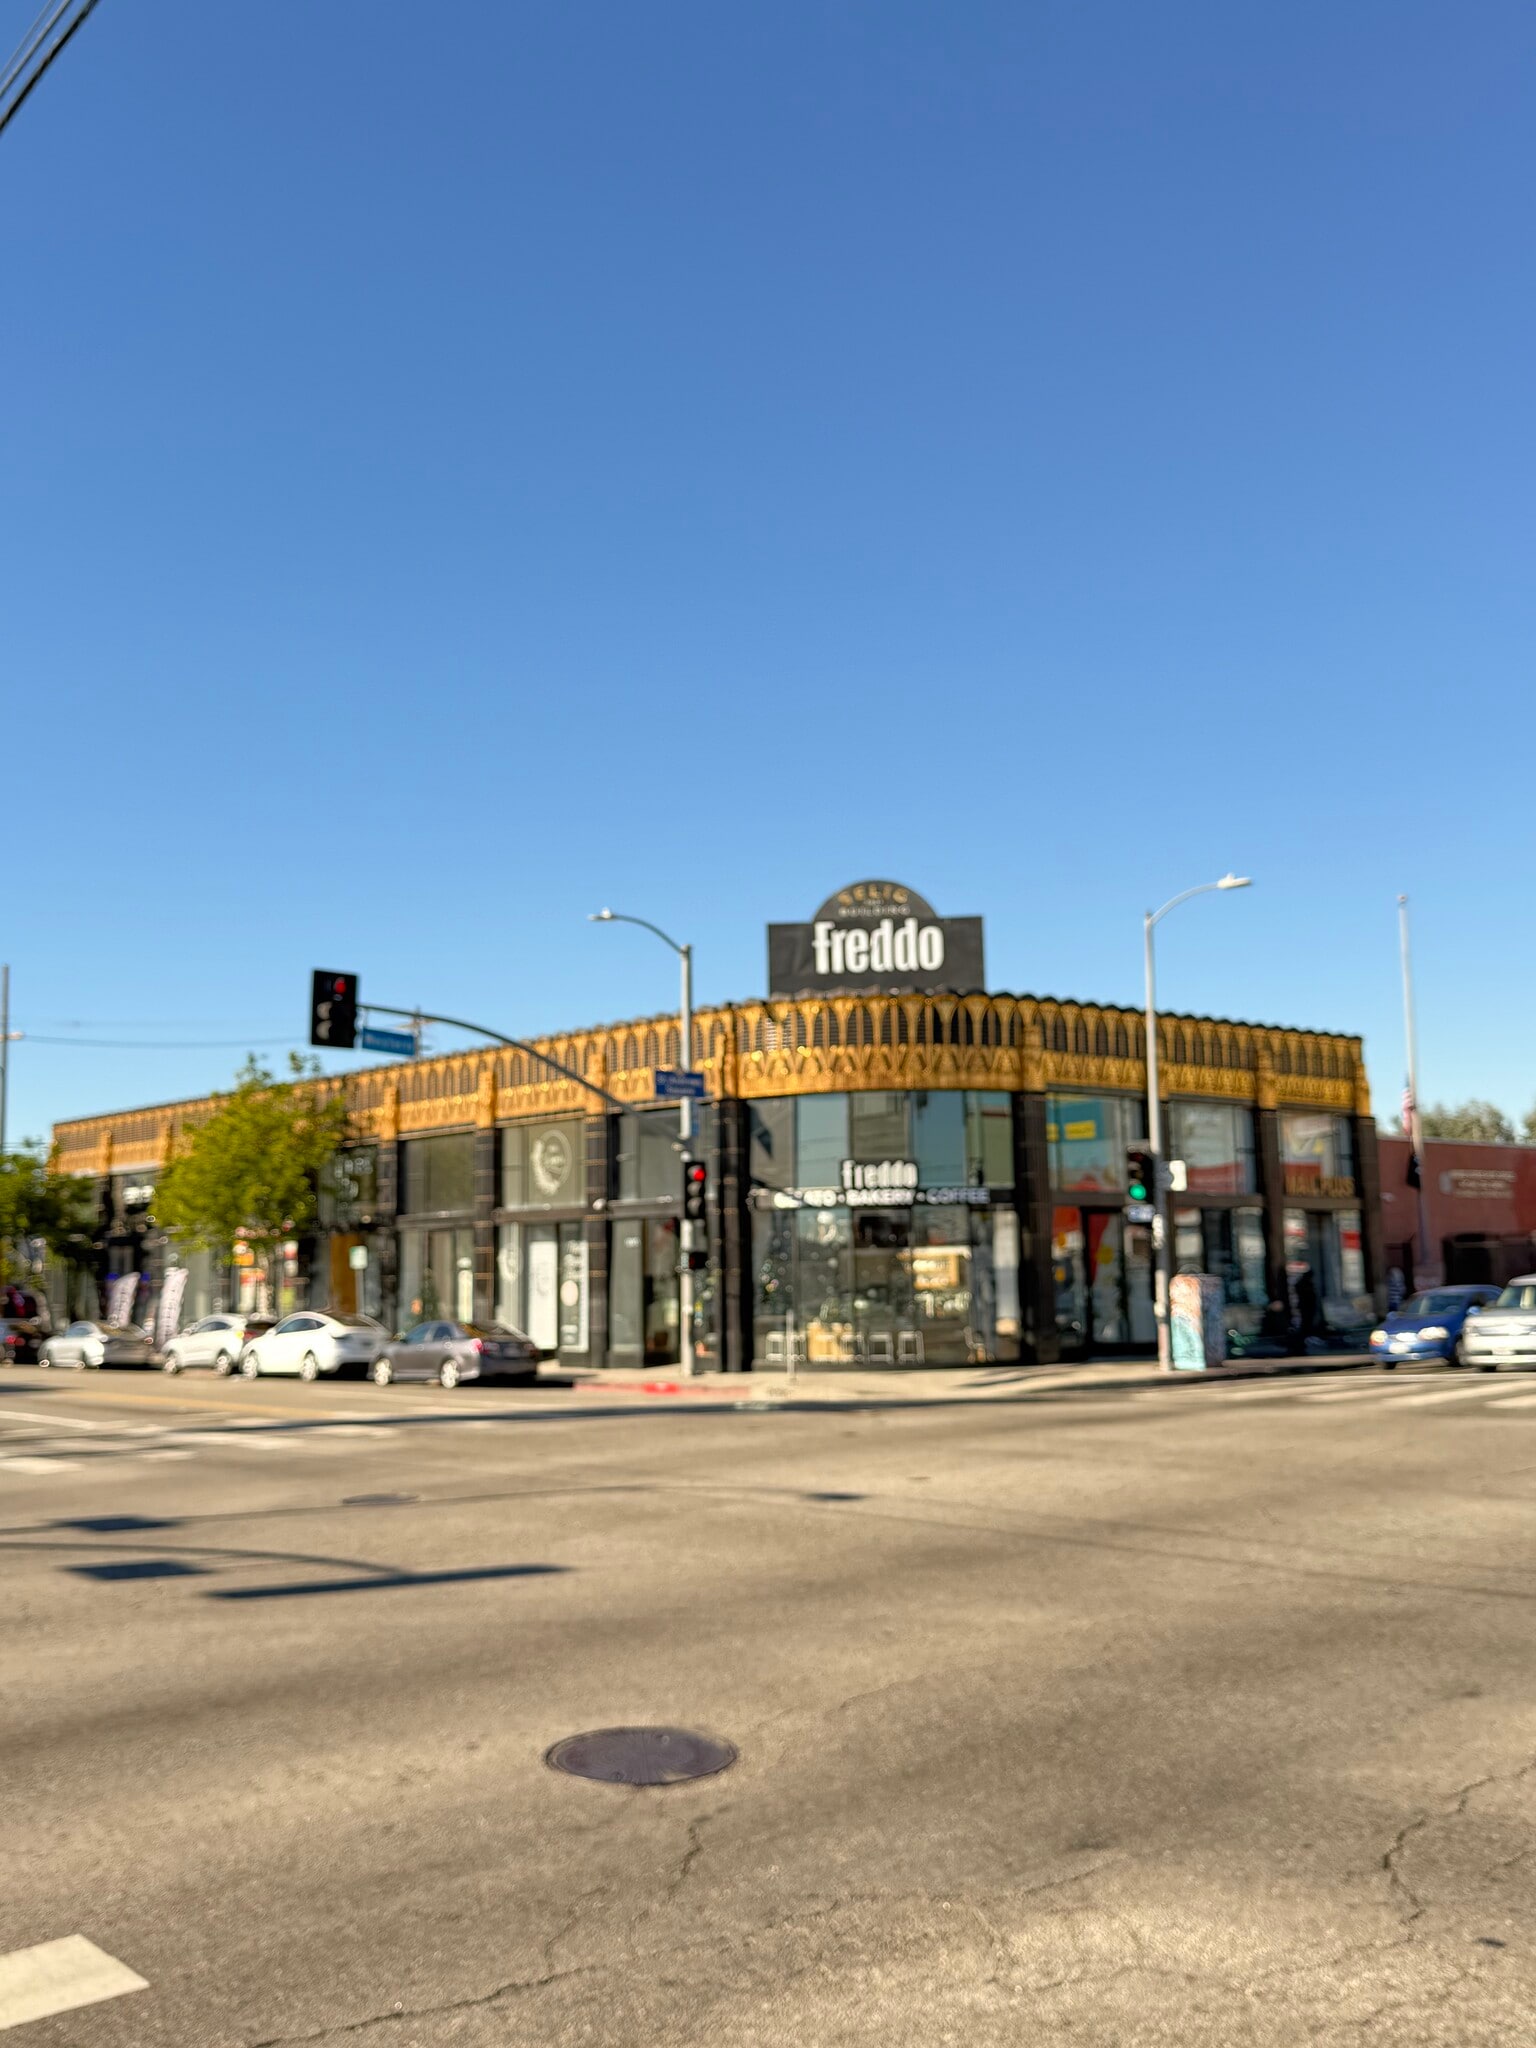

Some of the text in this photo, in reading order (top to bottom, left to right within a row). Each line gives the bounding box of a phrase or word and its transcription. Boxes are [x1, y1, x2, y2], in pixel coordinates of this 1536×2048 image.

[837, 884, 909, 906] SELIG
[811, 917, 945, 975] freddo
[842, 1159, 919, 1190] freddo
[845, 1188, 916, 1207] BAKERY
[925, 1187, 990, 1205] COFFEE
